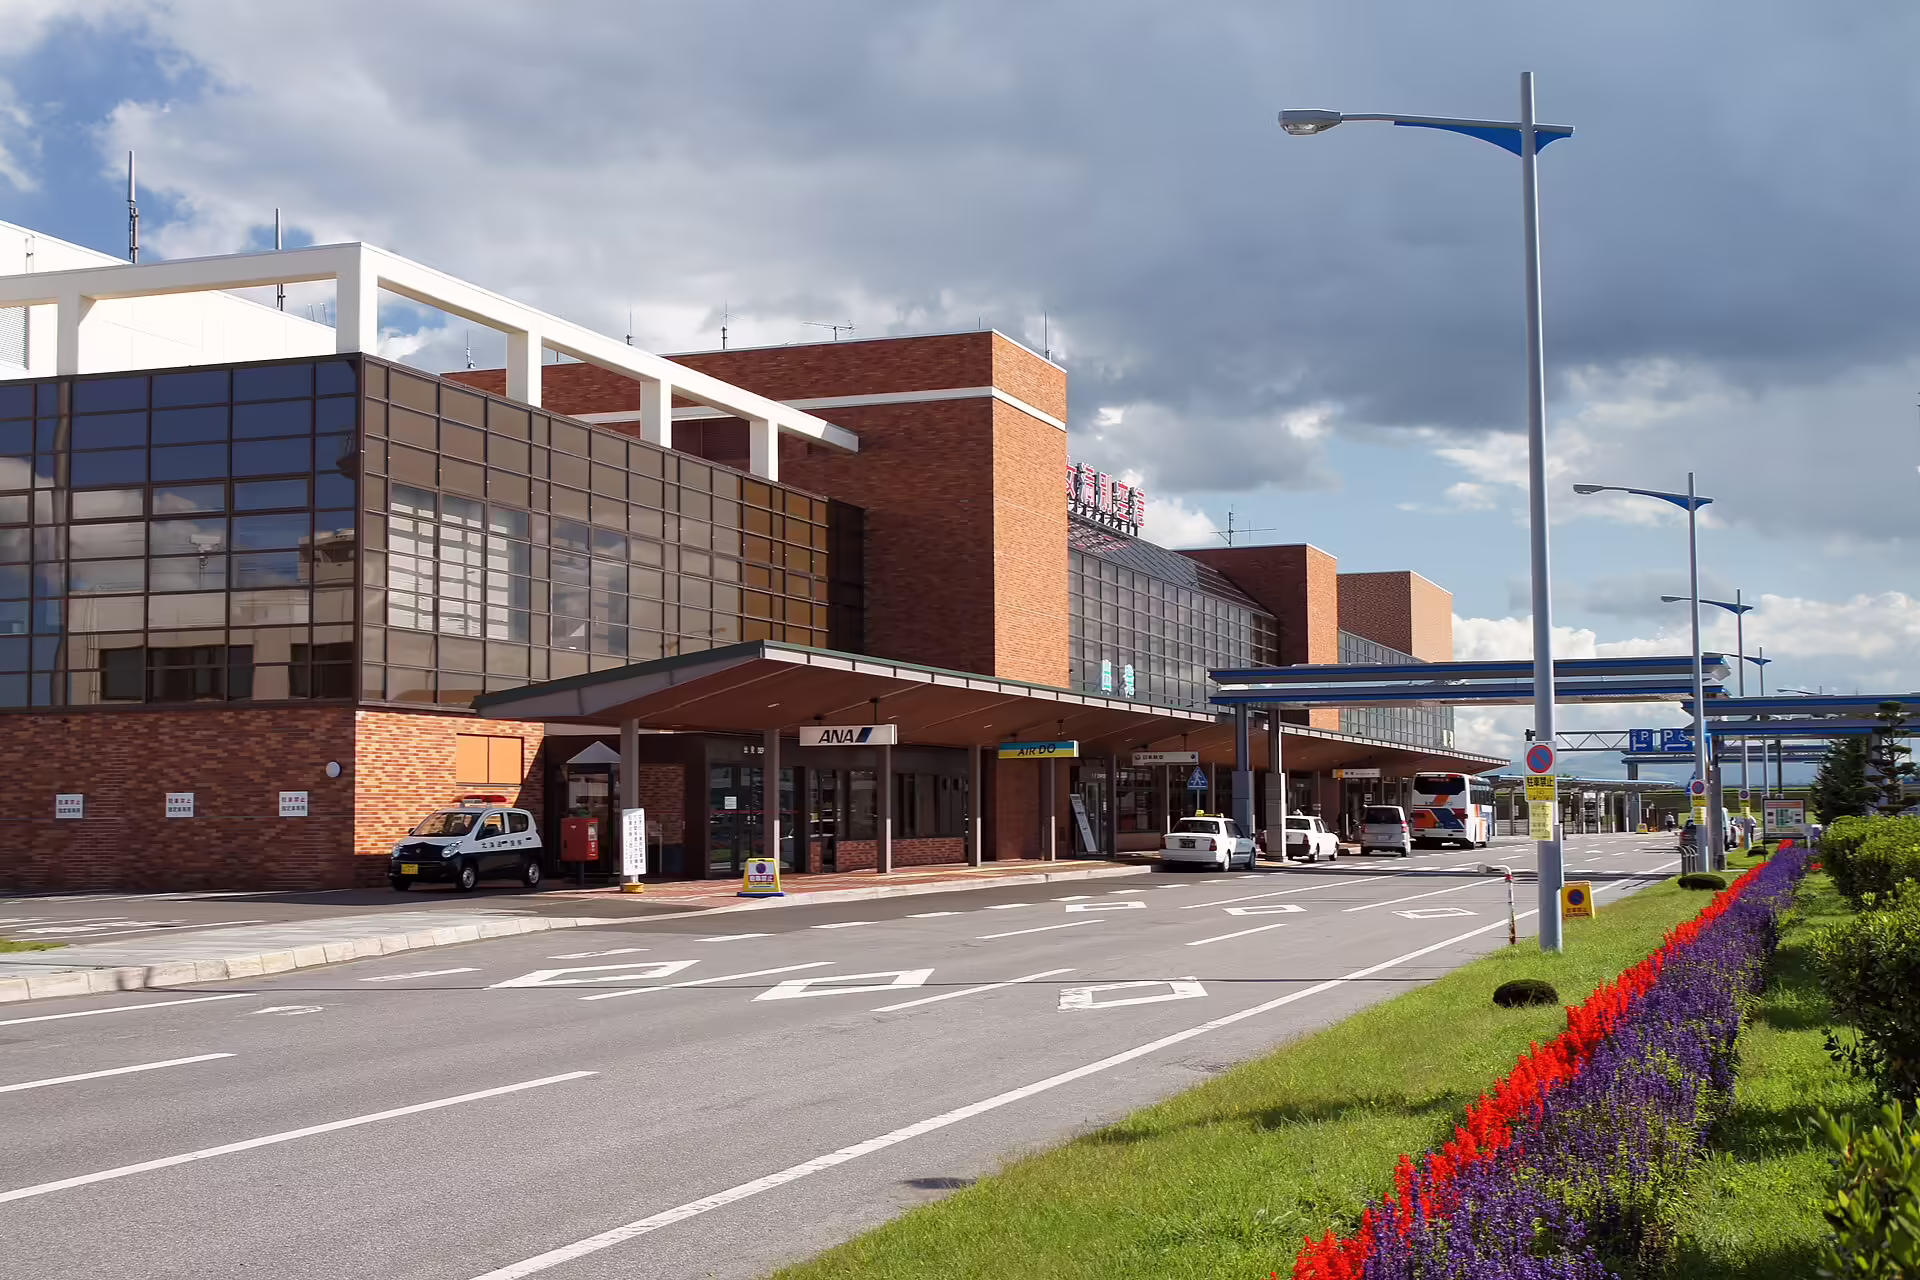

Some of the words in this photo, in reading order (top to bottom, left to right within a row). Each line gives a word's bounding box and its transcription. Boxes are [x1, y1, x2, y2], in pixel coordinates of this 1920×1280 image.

[818, 729, 854, 744] ANA
[1641, 731, 1649, 741] P
[1664, 730, 1673, 742] P
[1017, 747, 1036, 756] AIR
[1038, 743, 1056, 754] DO
[1527, 776, 1554, 787] 駐車禁止
